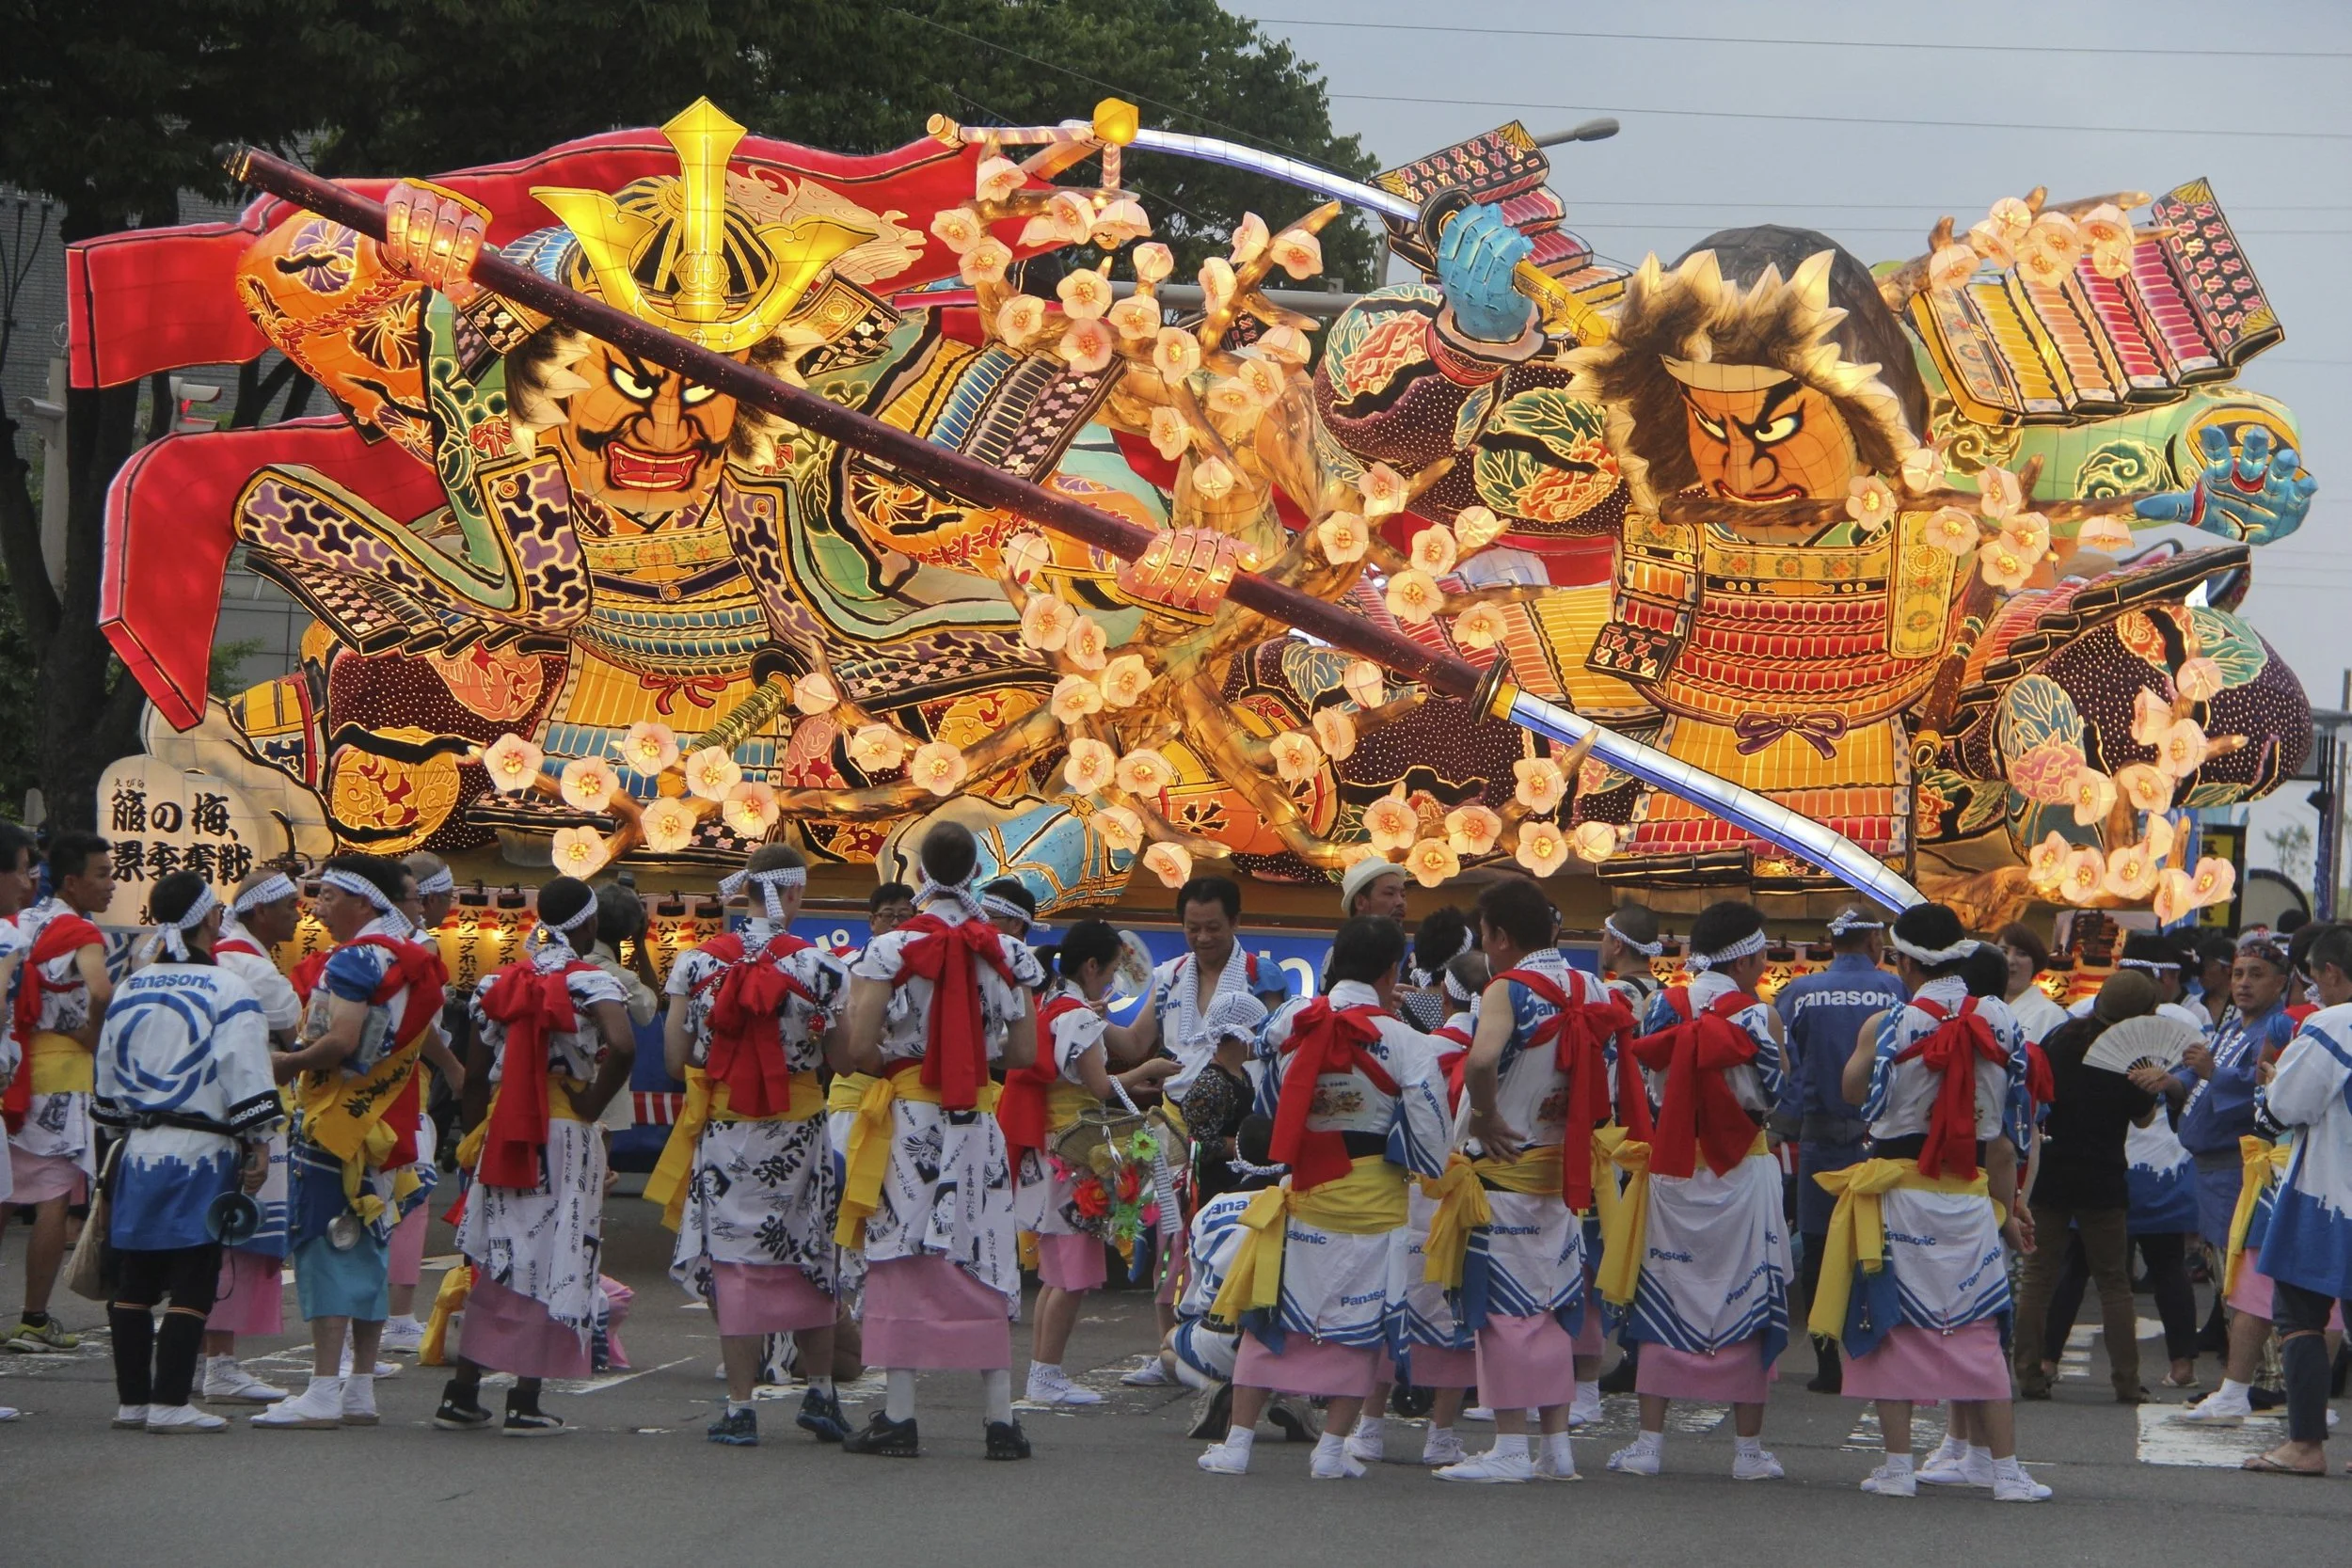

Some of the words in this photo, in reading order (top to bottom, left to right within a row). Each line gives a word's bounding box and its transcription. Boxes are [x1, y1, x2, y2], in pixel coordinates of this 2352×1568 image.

[114, 778, 145, 788] えびら
[111, 840, 253, 886] 景季奮戦
